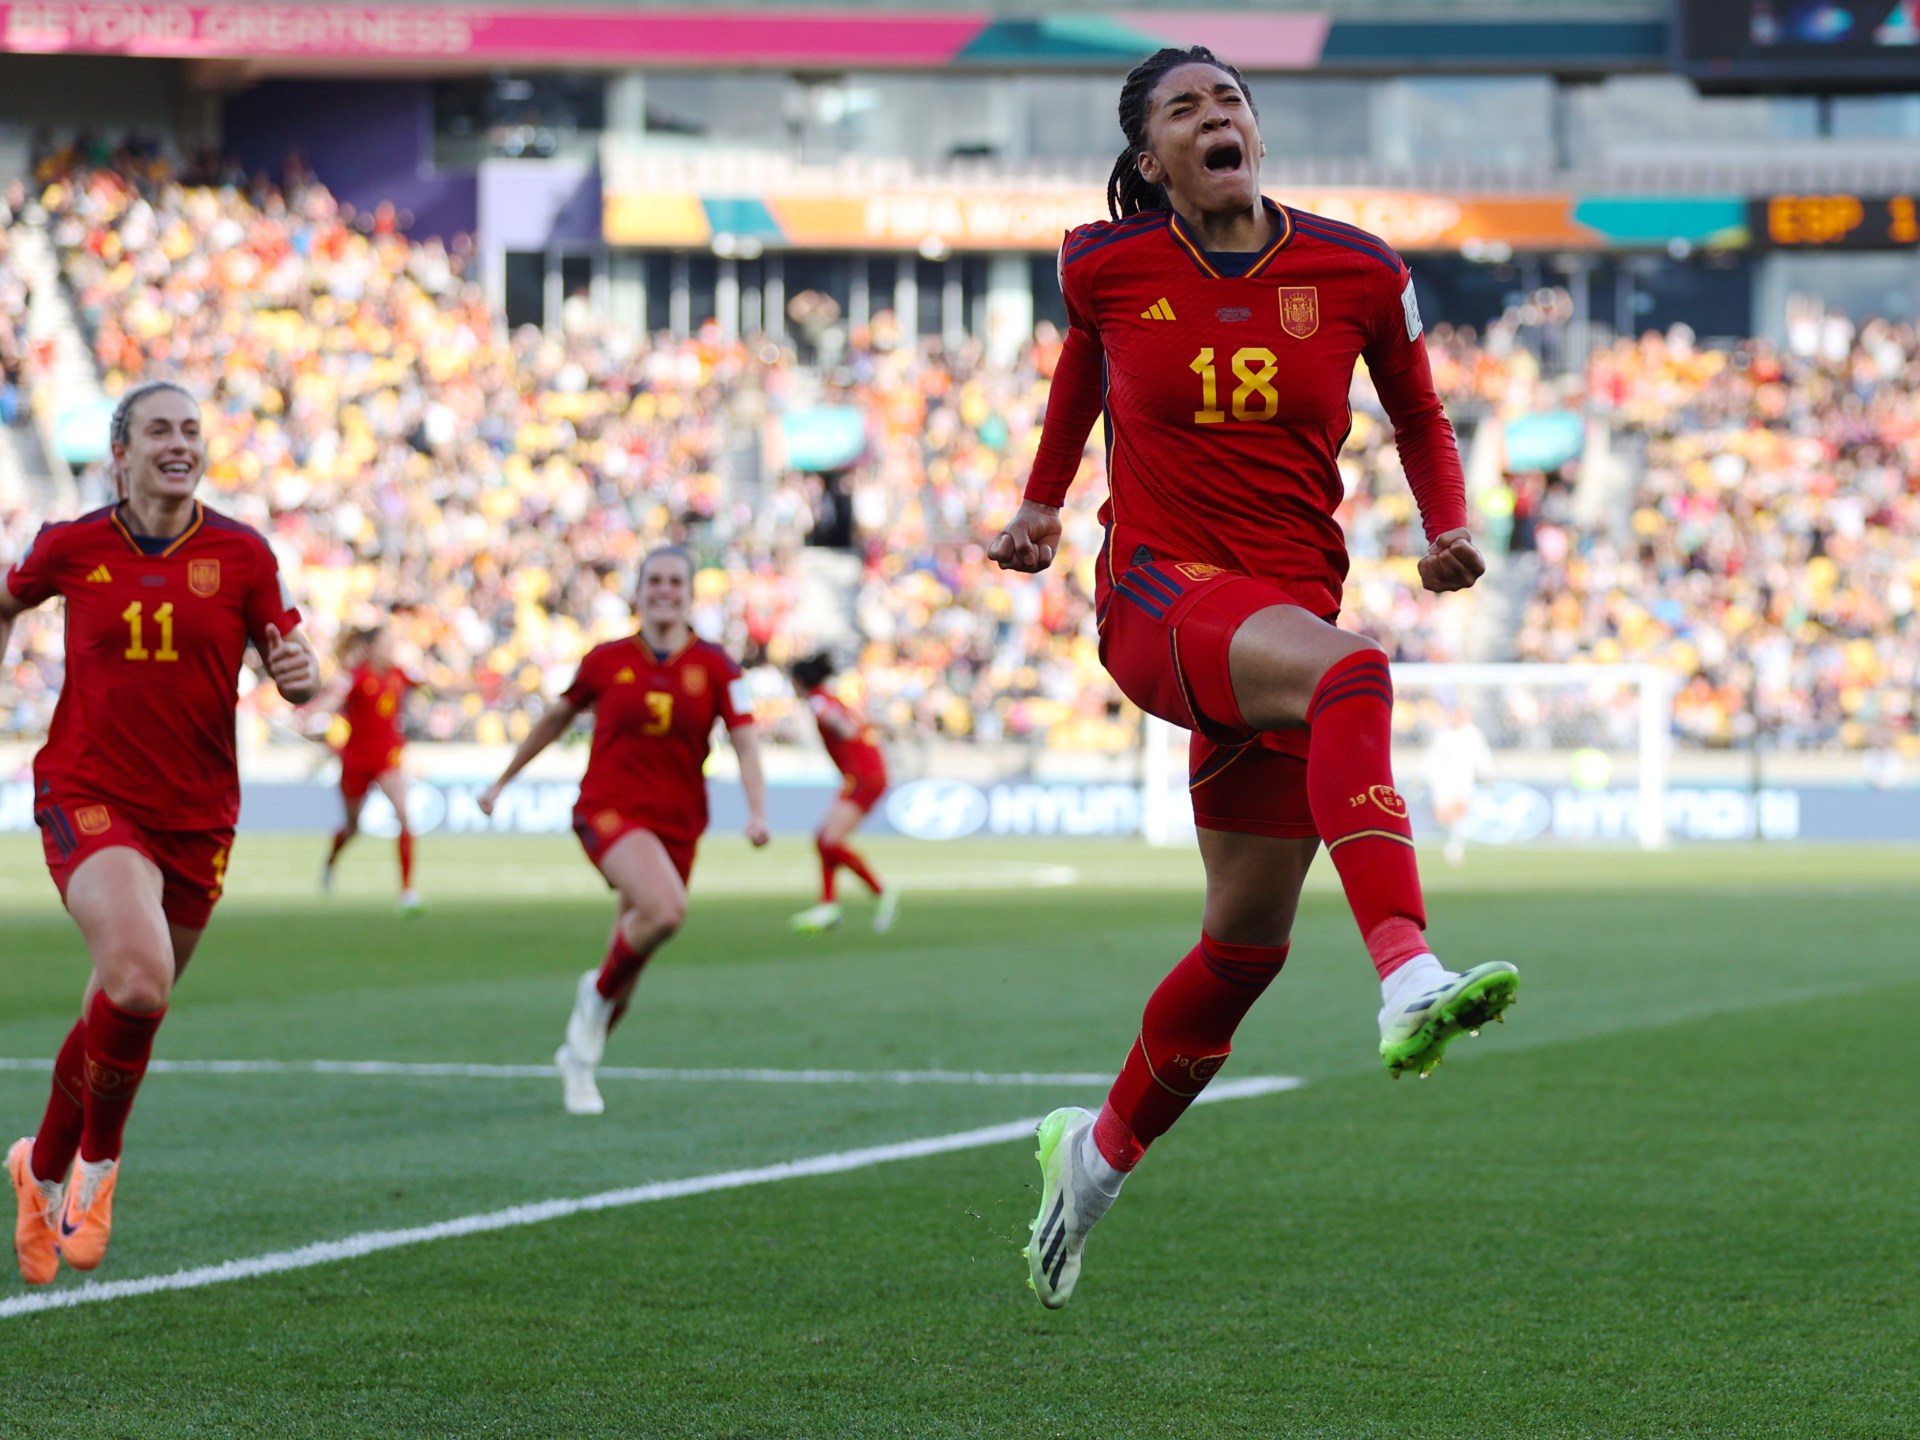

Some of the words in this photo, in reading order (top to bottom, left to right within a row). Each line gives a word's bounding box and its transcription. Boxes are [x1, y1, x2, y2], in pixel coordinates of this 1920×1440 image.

[8, 9, 194, 49] BEYOND
[1767, 194, 1865, 244] ESP
[1887, 194, 1920, 243] 1
[1189, 347, 1279, 424] 18
[121, 600, 179, 662] 11
[1349, 793, 1367, 807] 19
